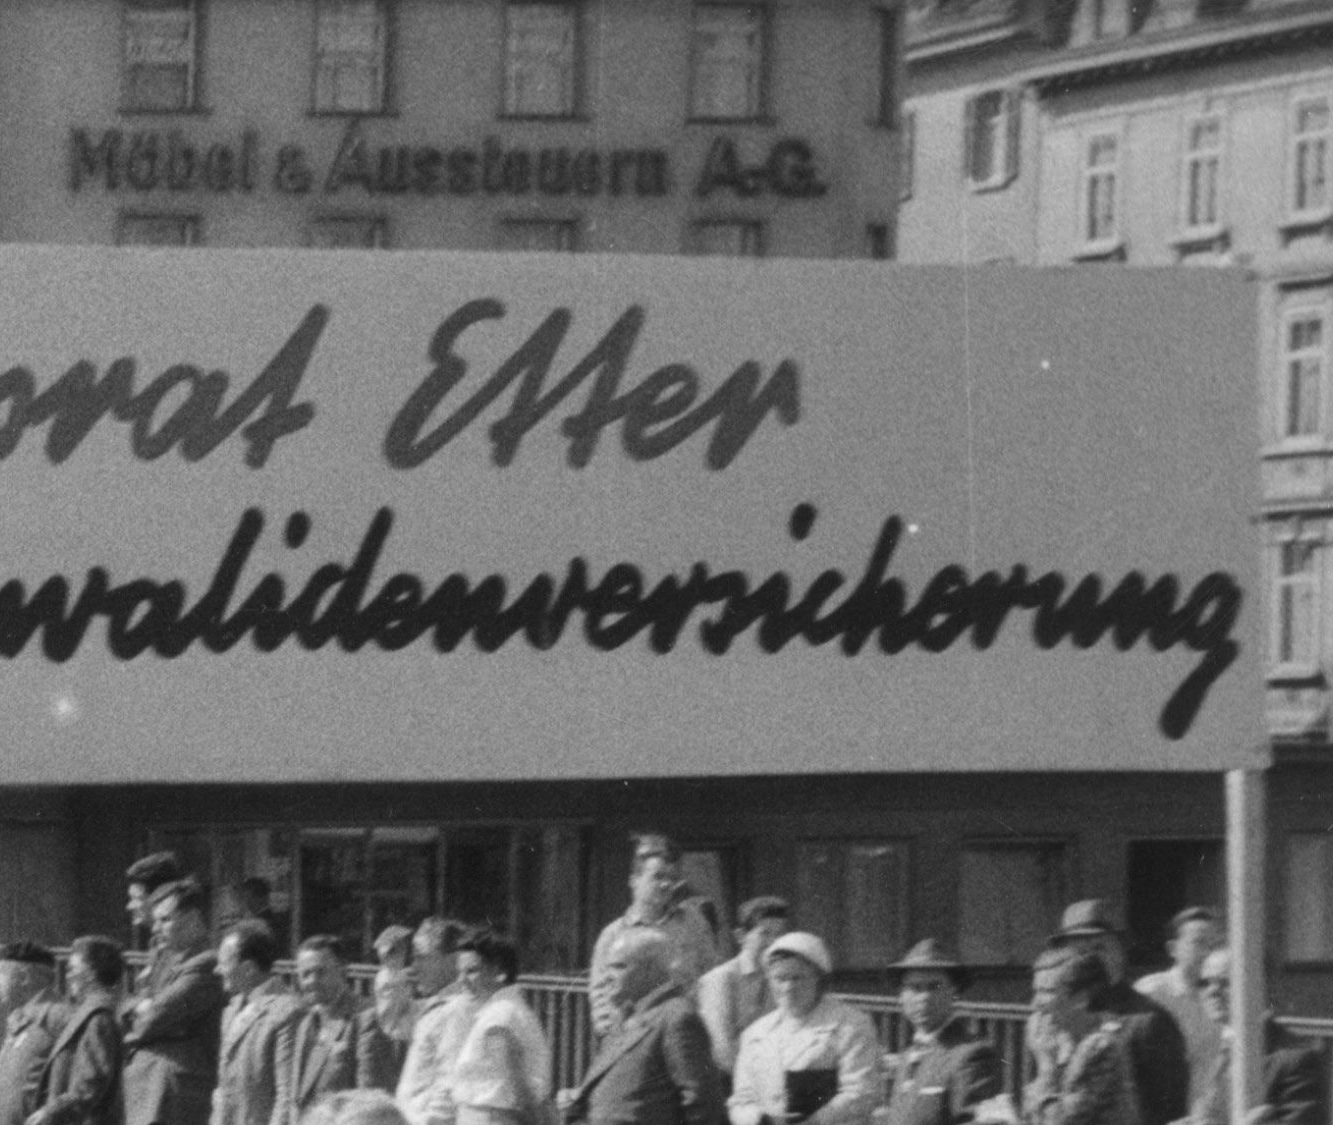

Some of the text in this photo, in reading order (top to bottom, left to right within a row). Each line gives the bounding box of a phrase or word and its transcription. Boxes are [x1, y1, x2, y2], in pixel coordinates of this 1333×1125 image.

[68, 127, 258, 192] Möbel
[274, 144, 314, 194] &
[323, 132, 669, 197] Aussteuern
[383, 297, 801, 468] Etter
